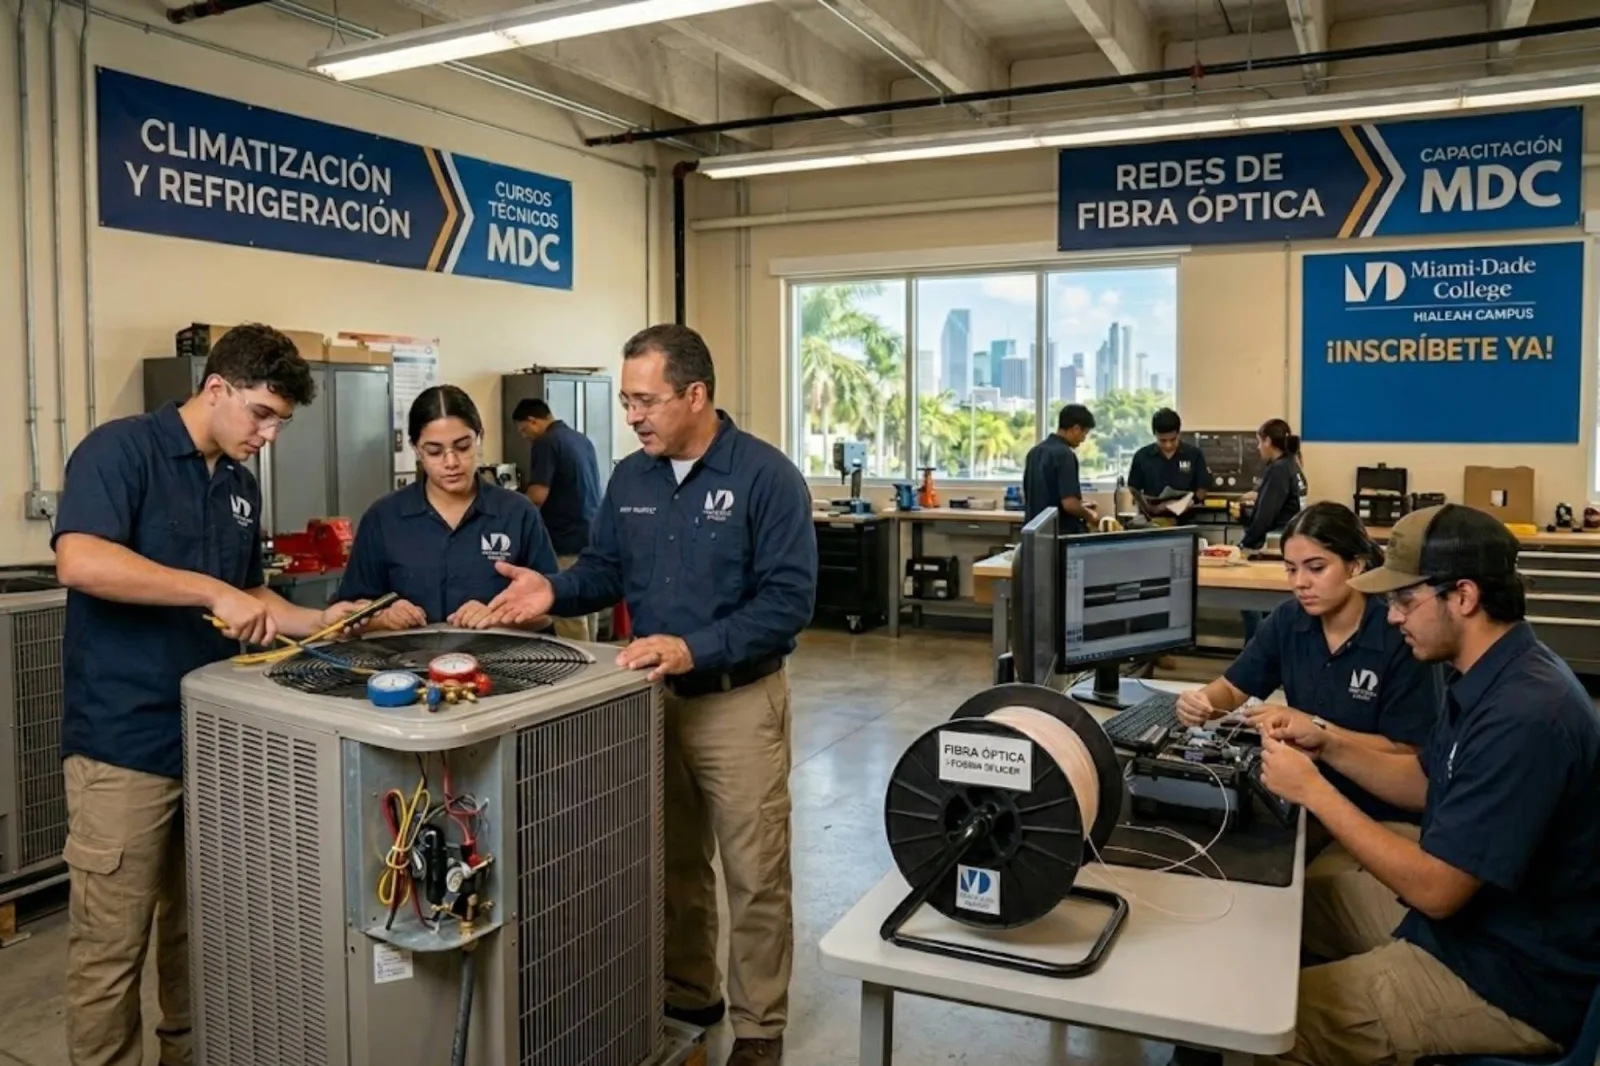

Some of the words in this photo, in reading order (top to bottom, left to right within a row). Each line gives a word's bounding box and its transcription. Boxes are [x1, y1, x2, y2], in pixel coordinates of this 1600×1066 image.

[140, 118, 393, 196] CLIMATIZACIÓN
[1420, 133, 1562, 162] CAPACITACIÓN
[1116, 157, 1225, 191] REDES
[1236, 152, 1283, 184] DE
[1420, 159, 1562, 212] MDC
[125, 161, 149, 196] Y
[159, 167, 410, 239] REFRIGERACIÓN
[495, 180, 552, 207] CURSOS
[488, 200, 559, 229] TÉCNICOS
[1078, 198, 1178, 230] FIBRA
[1187, 188, 1325, 224] ÓPTICA
[487, 222, 561, 272] MDC
[1411, 256, 1536, 279] Miami-Dade
[1433, 280, 1512, 302] College
[1413, 311, 1472, 323] HIALEAH
[1475, 308, 1534, 322] CAMPUS
[1326, 333, 1498, 365] ¡INSCRÍBETE
[1505, 336, 1553, 360] YA!
[944, 744, 979, 757] FIBRA
[981, 746, 1026, 763] ÓPTICA
